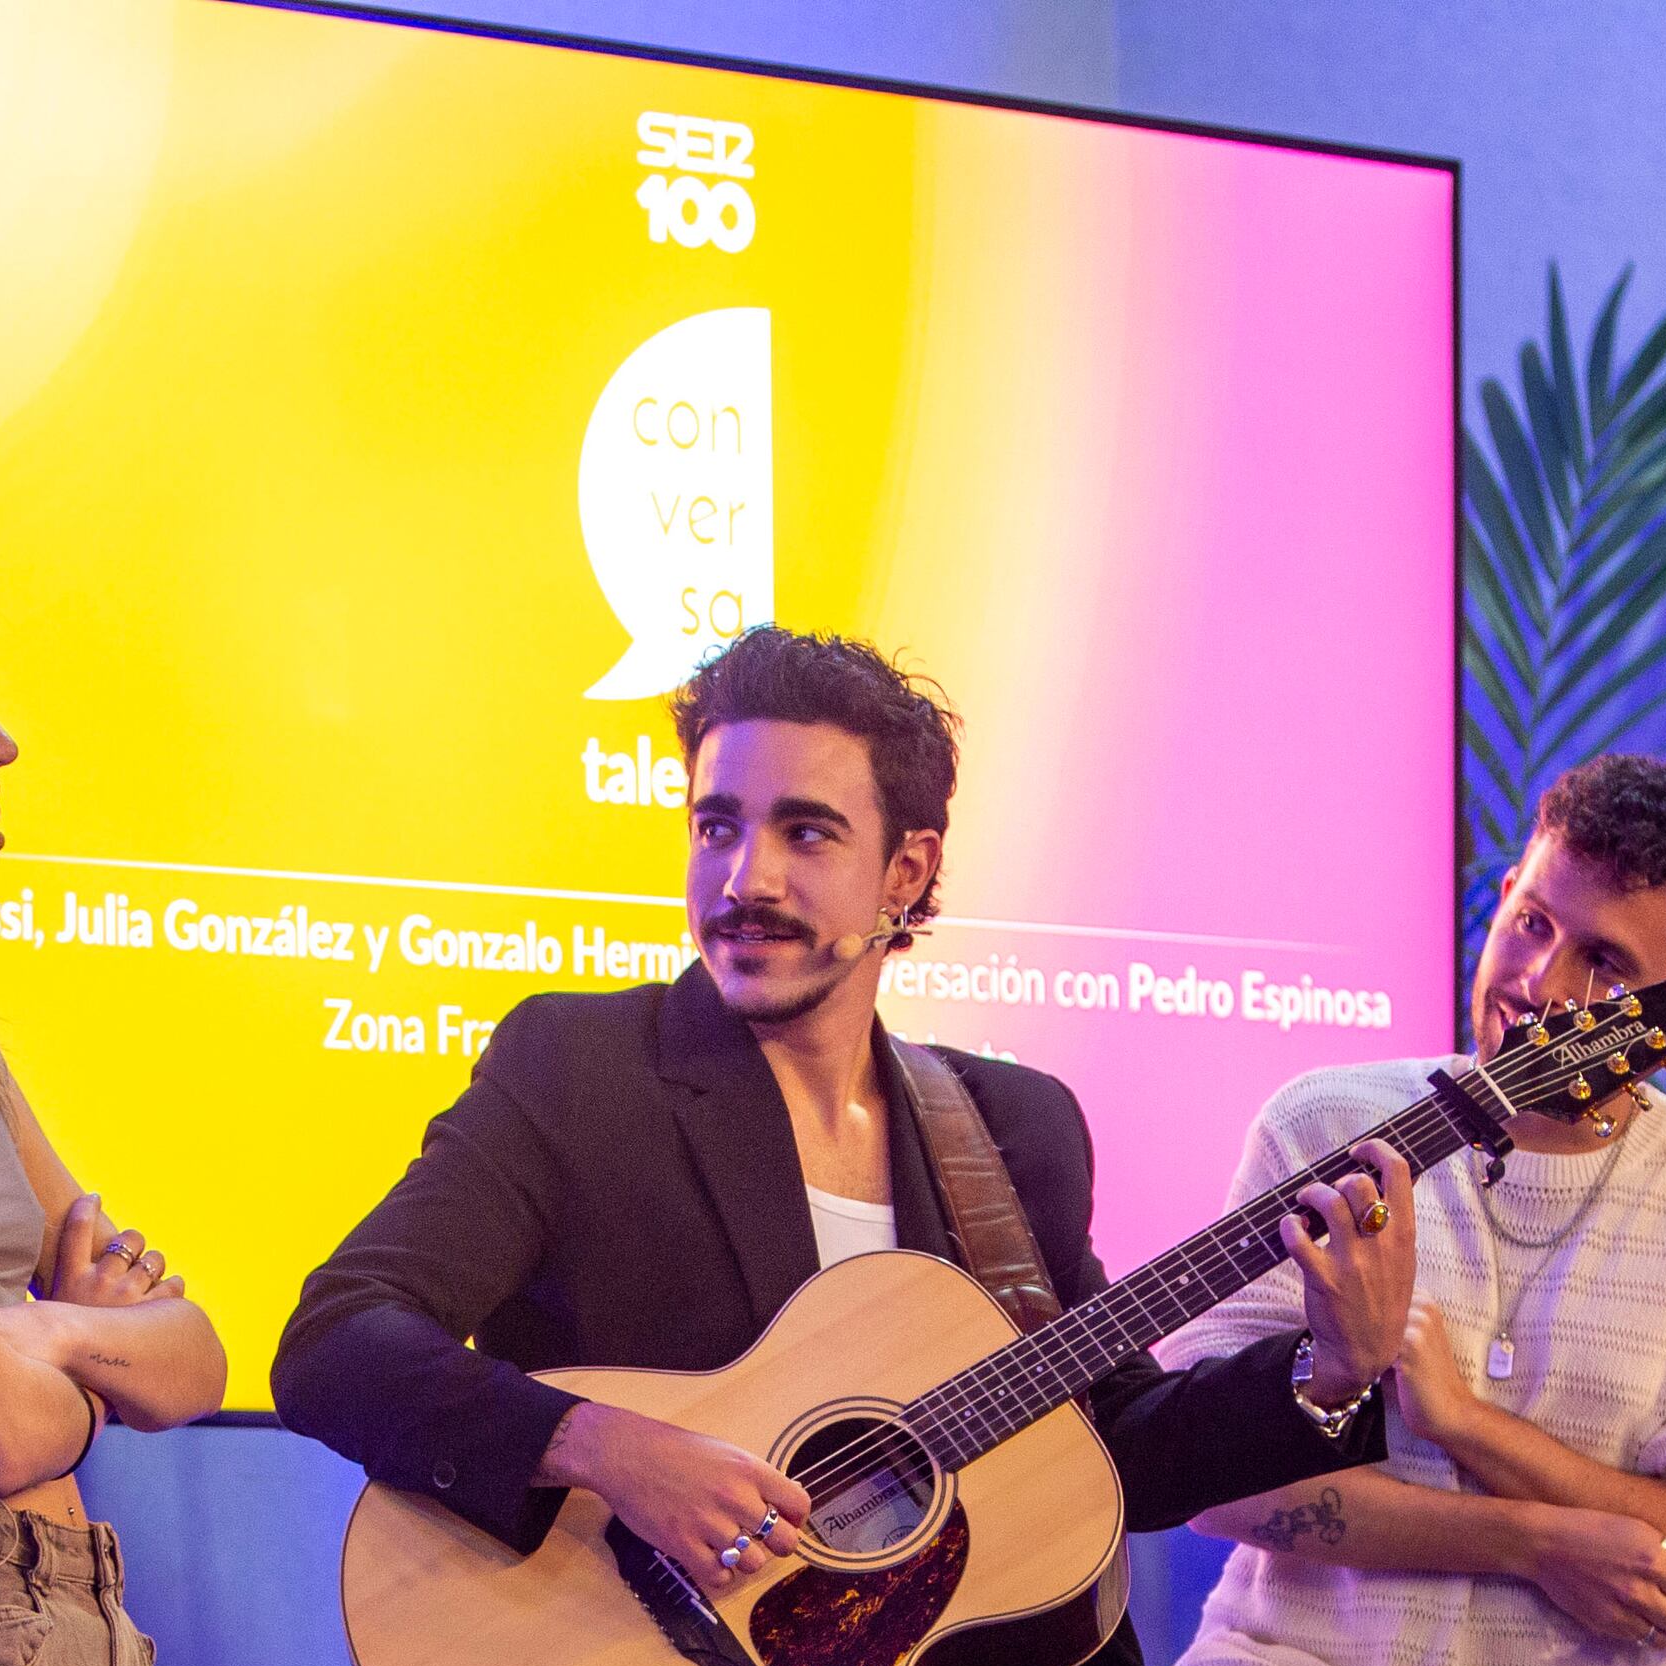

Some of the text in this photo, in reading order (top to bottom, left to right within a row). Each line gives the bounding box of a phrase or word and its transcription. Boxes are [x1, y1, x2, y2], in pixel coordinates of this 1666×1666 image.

[636, 111, 755, 180] SER
[636, 174, 756, 254] 100
[633, 396, 742, 455] con
[651, 491, 745, 546] ver
[681, 586, 743, 639] sa
[581, 735, 690, 809] tale
[55, 891, 154, 948] Julia
[163, 898, 354, 961] González
[363, 925, 389, 974] y
[398, 913, 563, 975] Gonzalo
[573, 925, 700, 980] Hermi
[878, 952, 1047, 1005] versación
[1053, 969, 1120, 1009] con
[1127, 961, 1234, 1019] Pedro
[1240, 969, 1392, 1032] Espinosa
[322, 998, 499, 1056] Zona Fra
[1552, 1020, 1647, 1070] Alhambra
[822, 1485, 899, 1538] Alhambra
